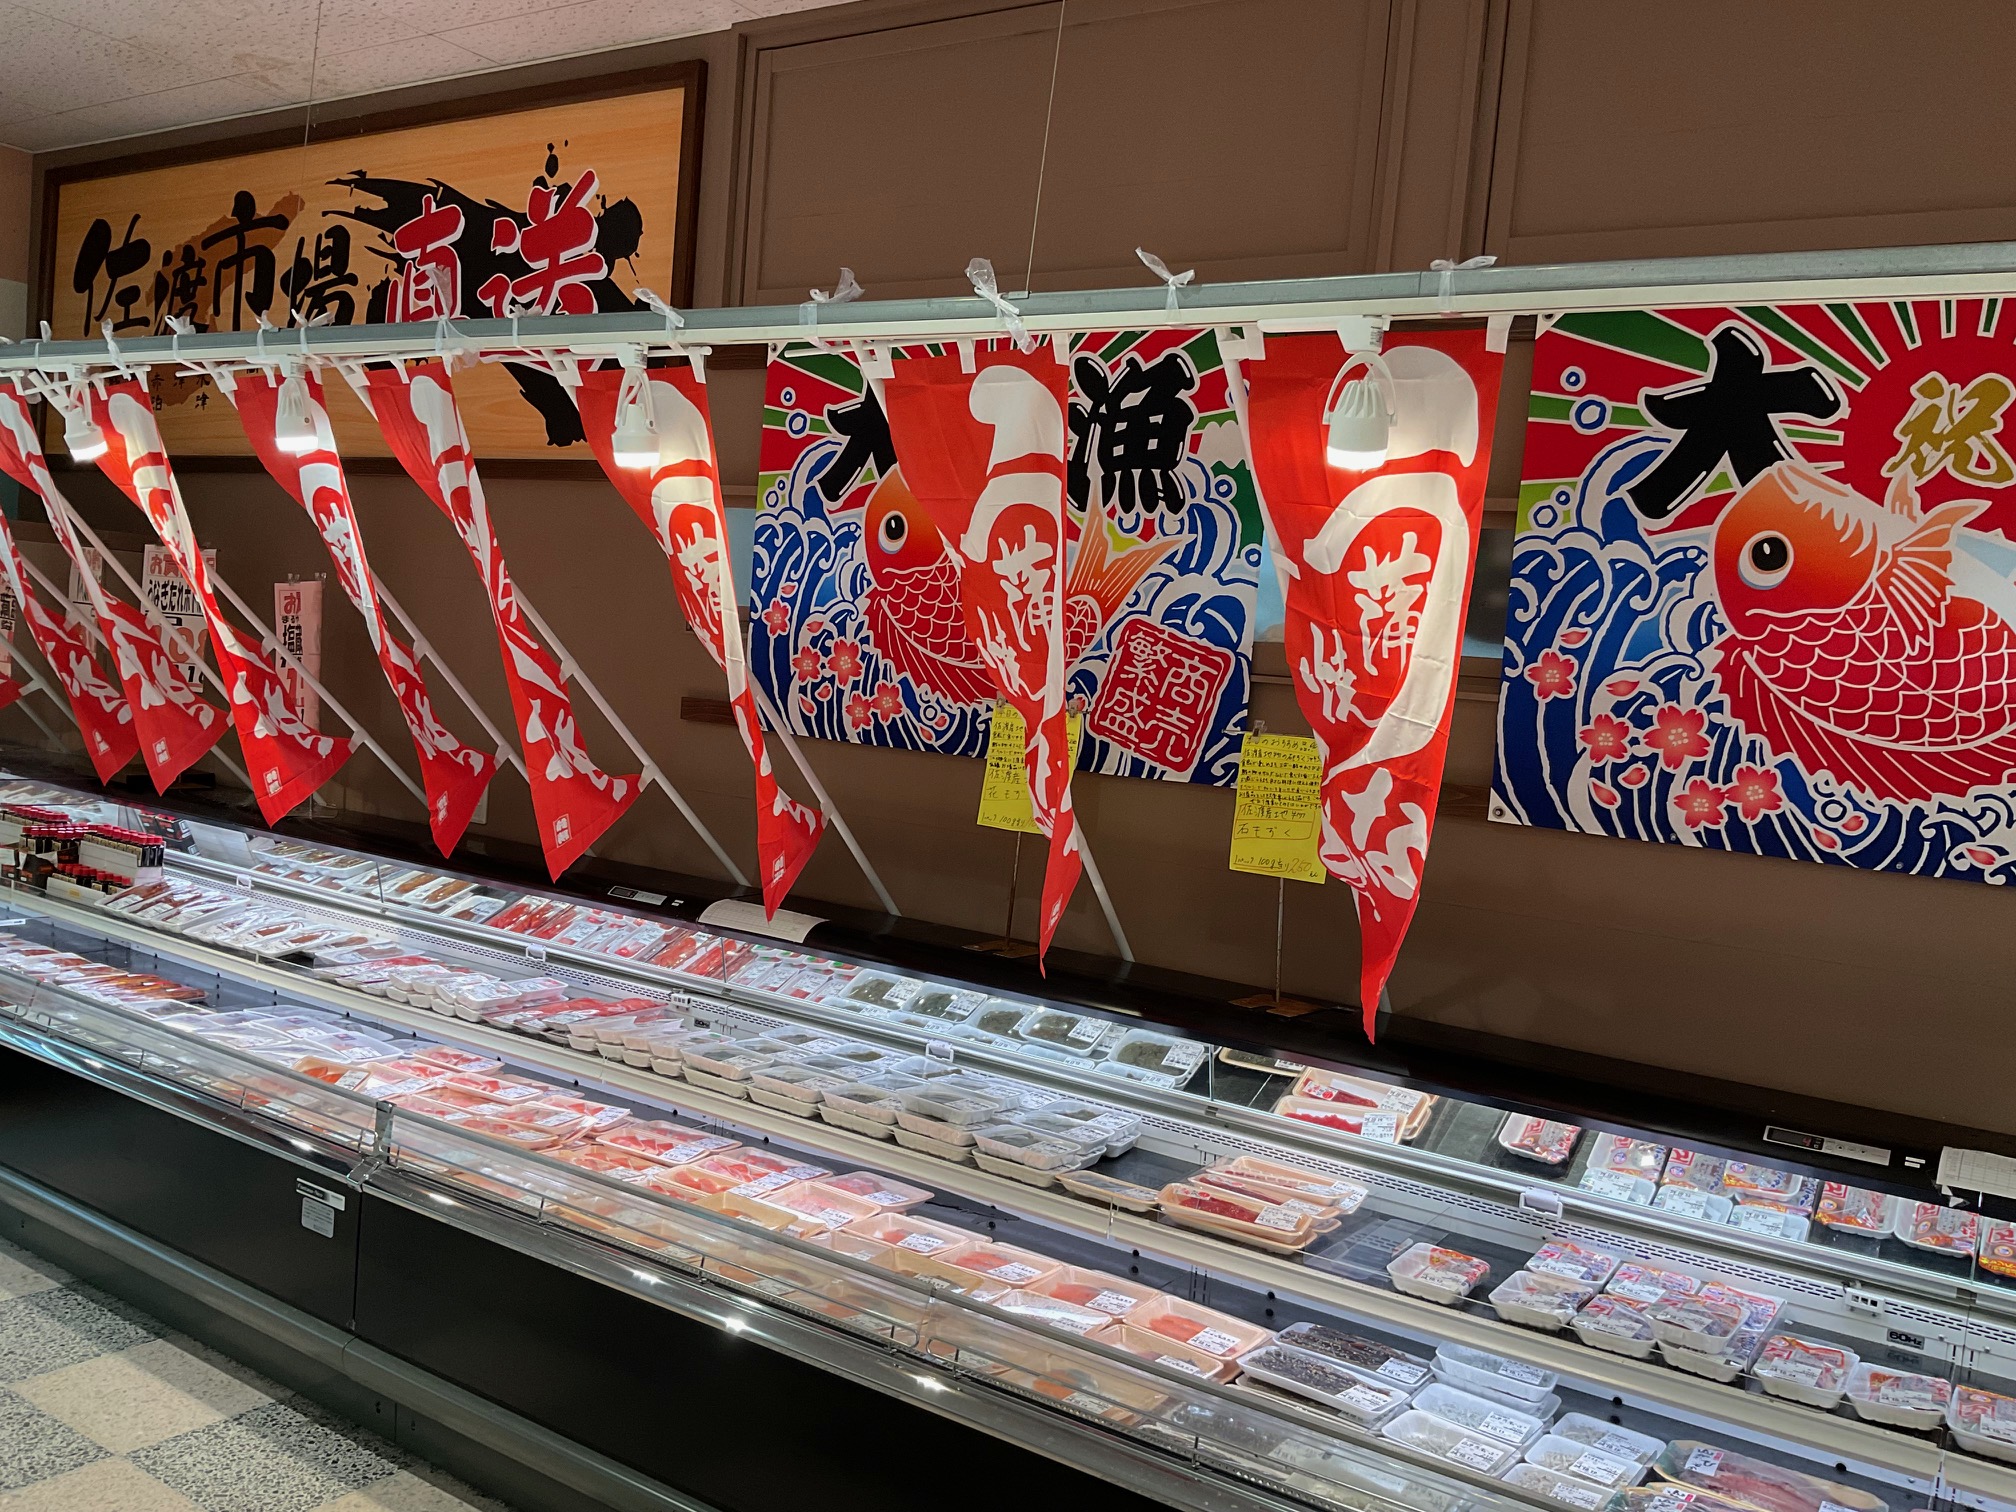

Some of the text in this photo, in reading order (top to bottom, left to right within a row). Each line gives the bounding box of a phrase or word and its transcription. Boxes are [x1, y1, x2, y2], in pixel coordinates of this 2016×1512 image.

[1067, 353, 1199, 515] 漁
[1626, 326, 1842, 519] 大
[1888, 376, 2015, 482] 祝
[1889, 1331, 1923, 1346] 60Hz
